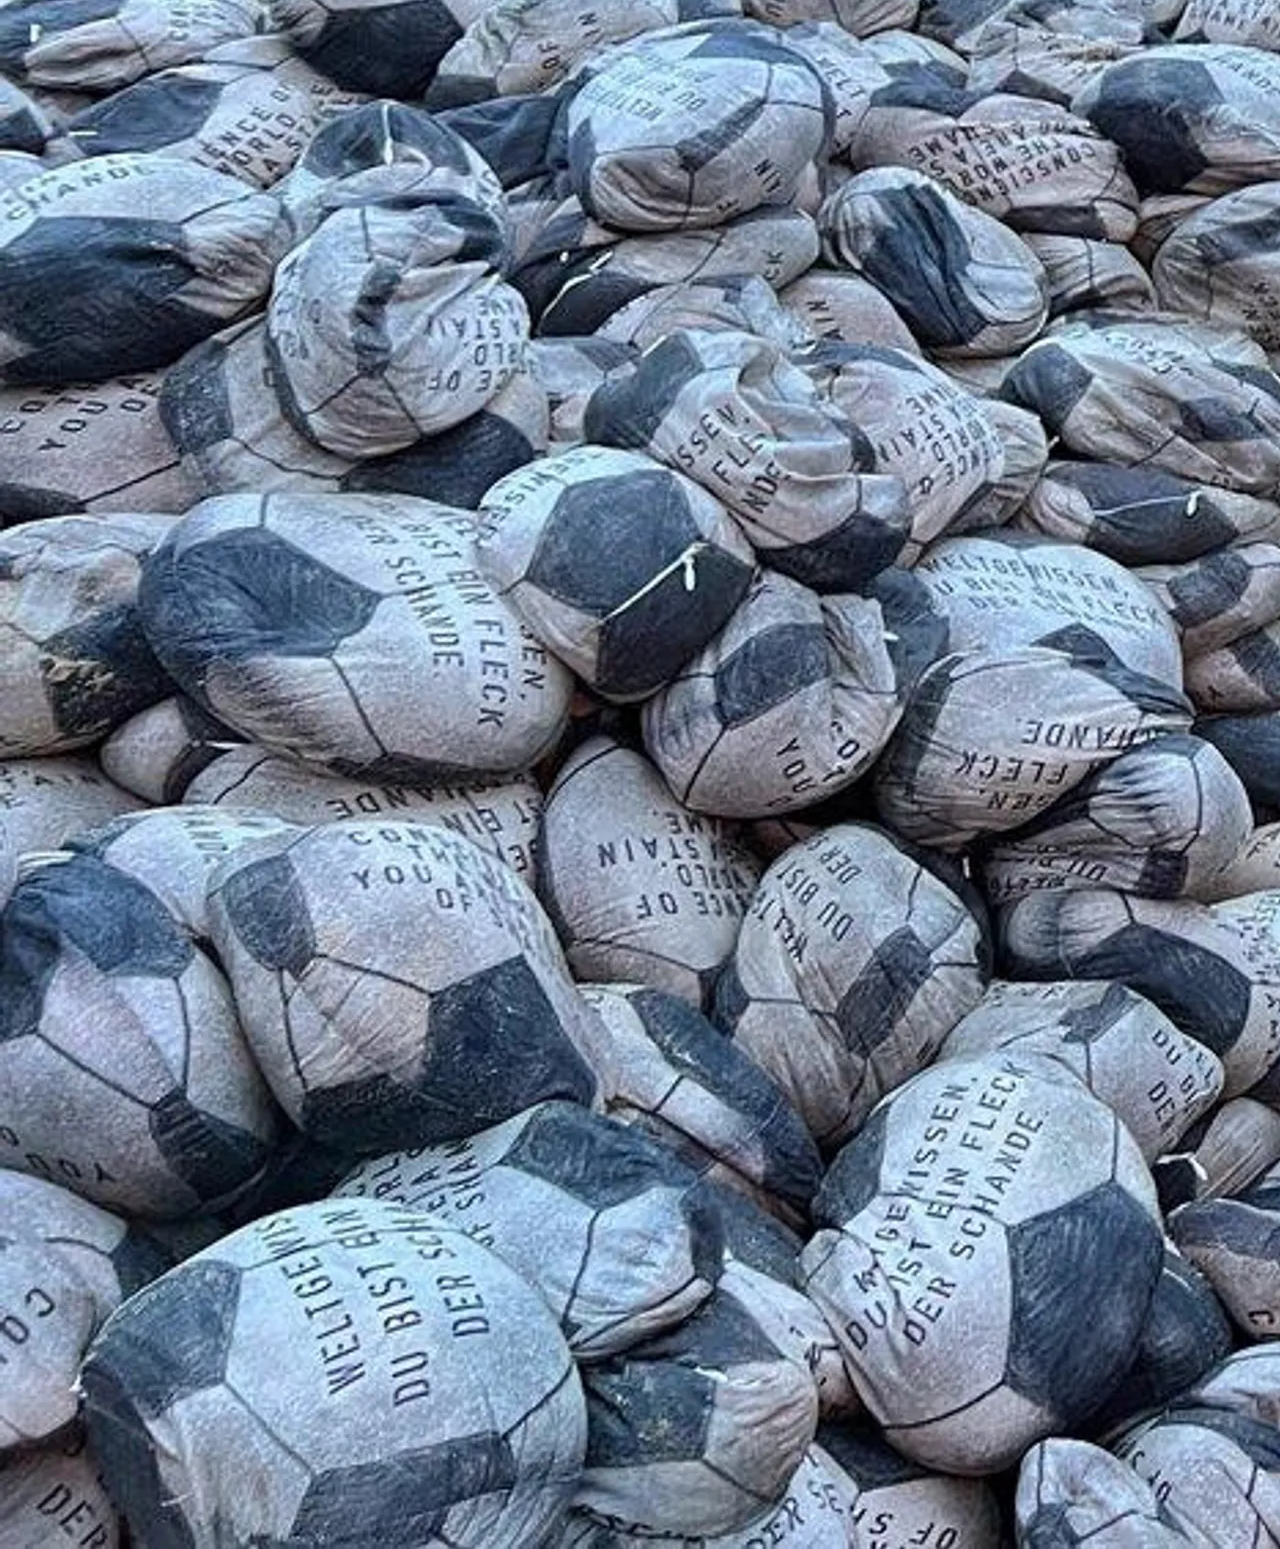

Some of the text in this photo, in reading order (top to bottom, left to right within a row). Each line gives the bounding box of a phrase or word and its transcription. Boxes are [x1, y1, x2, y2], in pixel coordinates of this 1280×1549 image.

[473, 617, 511, 728] FLECK
[954, 750, 1069, 784] FLECK
[353, 865, 433, 890] YOU
[819, 851, 863, 886] DER
[636, 891, 680, 919] OF
[818, 902, 855, 941] DU
[844, 1300, 888, 1350] DU
[926, 1166, 971, 1221] EIN
[961, 1061, 1034, 1152] FLECK
[356, 1261, 423, 1335] BIST
[435, 1273, 490, 1337] DER
[902, 1274, 957, 1347] DER
[391, 1350, 431, 1407] DU
